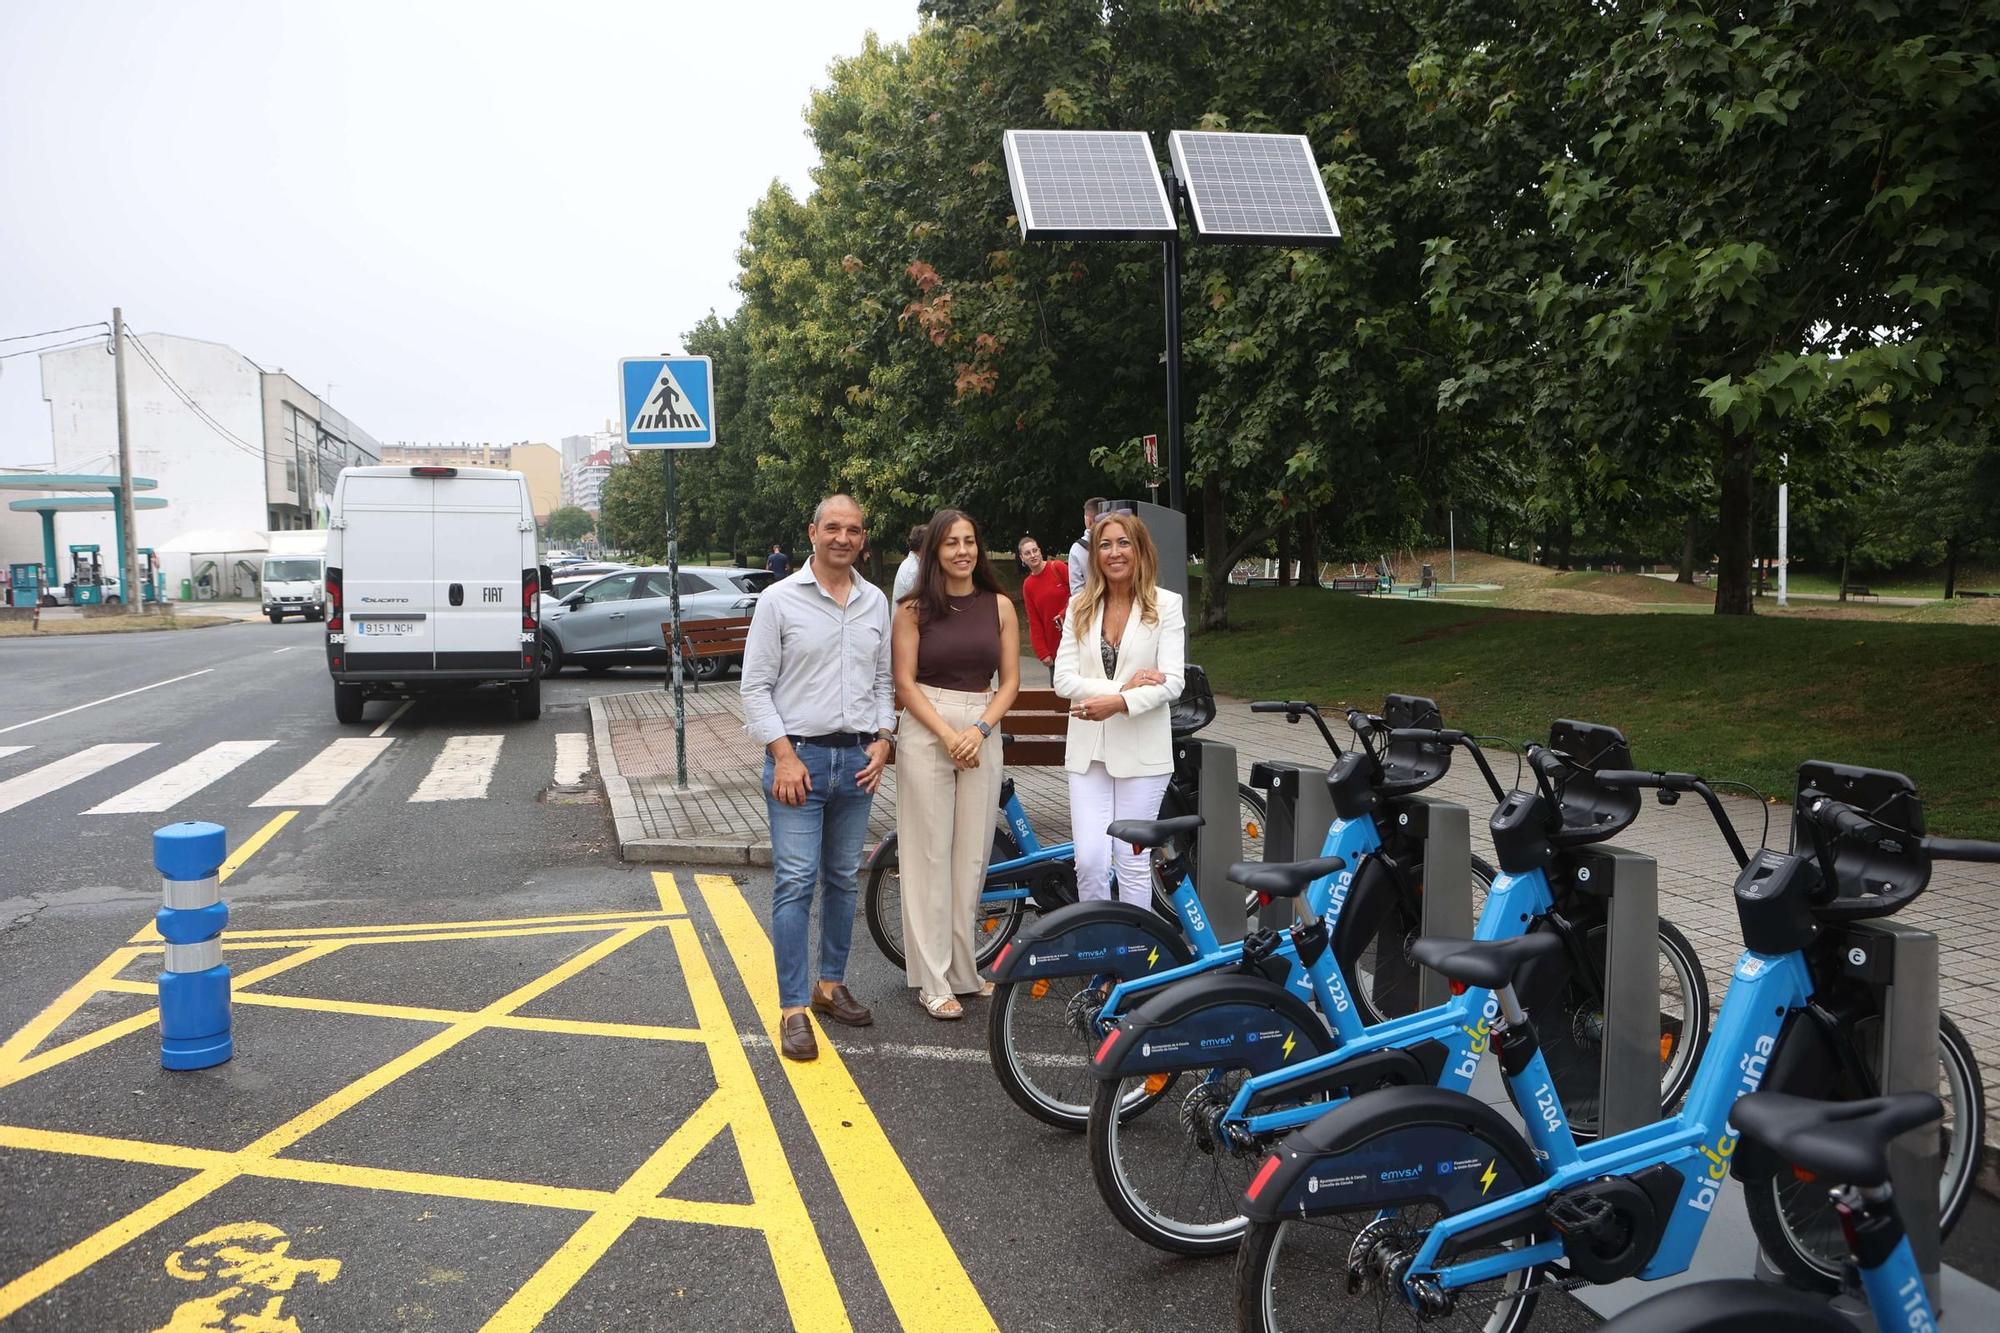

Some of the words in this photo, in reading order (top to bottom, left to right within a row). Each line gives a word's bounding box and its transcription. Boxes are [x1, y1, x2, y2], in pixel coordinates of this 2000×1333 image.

[483, 587, 503, 602] FIAT
[366, 623, 391, 633] 9151
[394, 623, 413, 633] NCH
[1015, 818, 1030, 838] 854
[1184, 898, 1205, 932] 1239
[1326, 972, 1348, 1013] 1220
[1535, 1083, 1562, 1133] 1204
[1688, 1034, 1776, 1212] bicicuña
